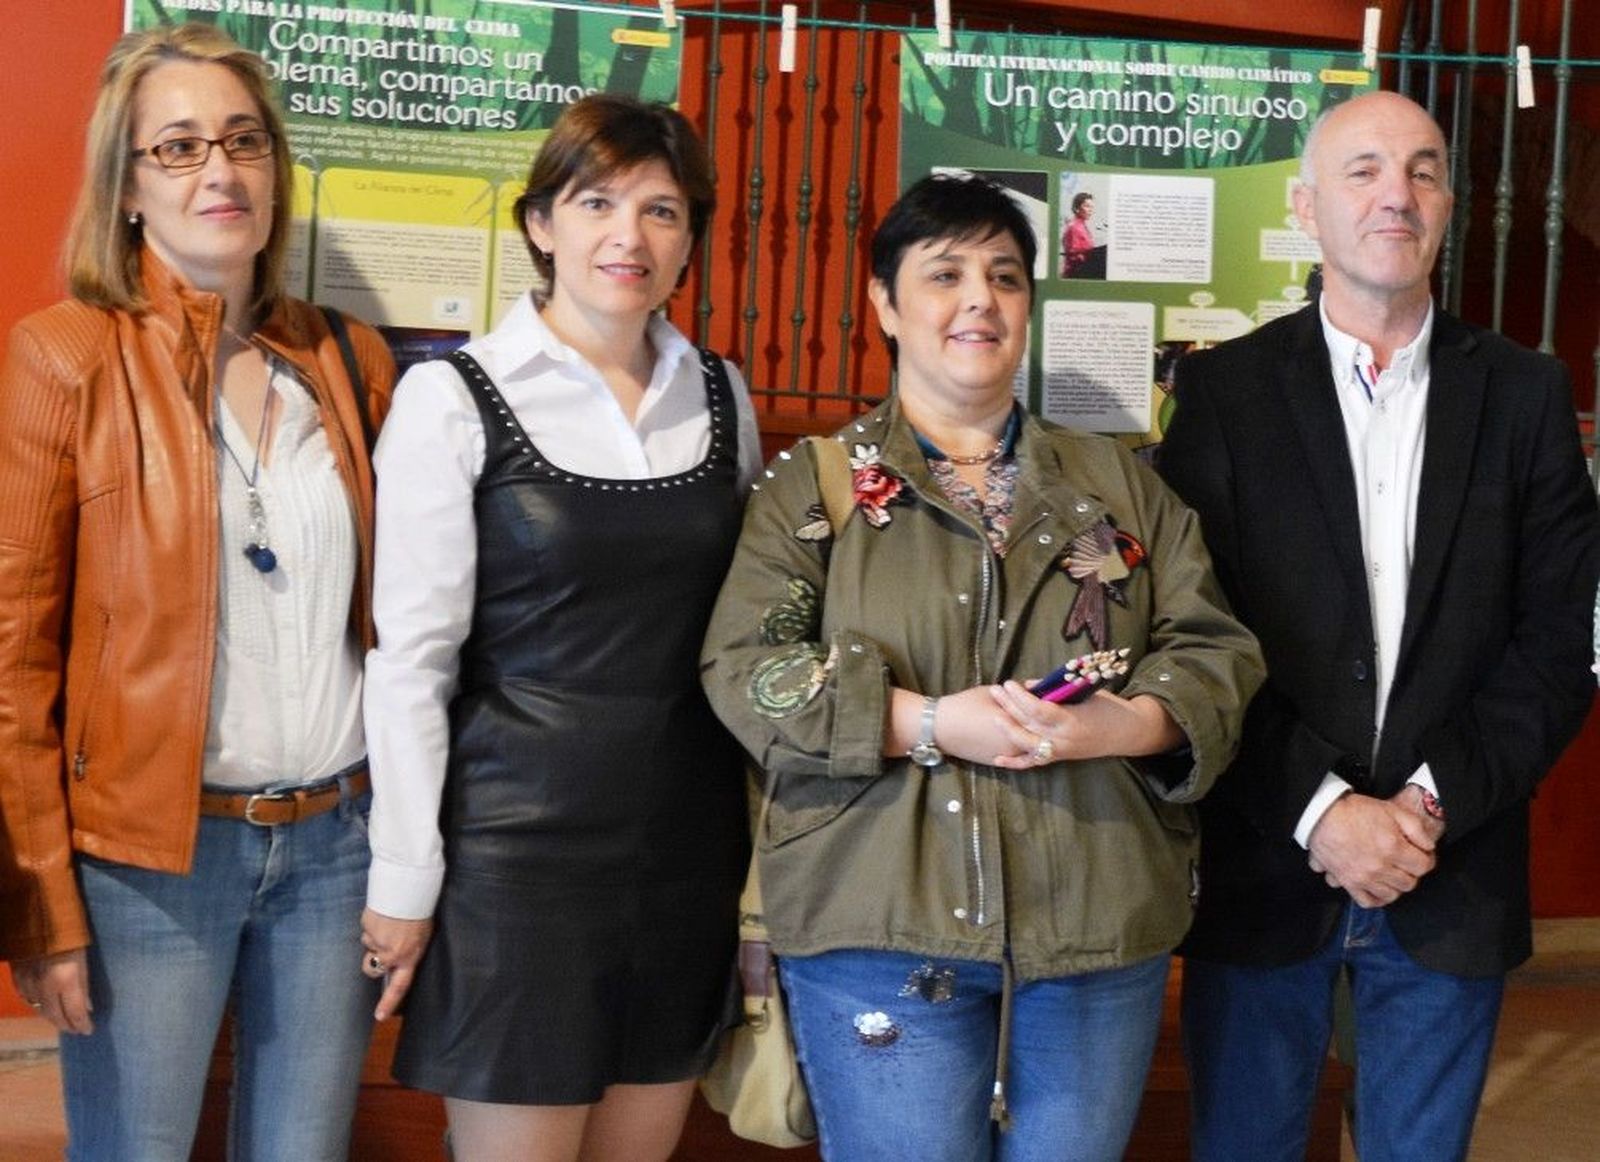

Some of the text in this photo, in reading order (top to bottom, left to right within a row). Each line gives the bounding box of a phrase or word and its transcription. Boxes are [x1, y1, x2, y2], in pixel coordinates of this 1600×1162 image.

[226, 0, 276, 17] PARA
[280, 3, 303, 19] LA
[306, 5, 418, 28] PROTECCIÓN
[424, 15, 458, 33] DEL
[465, 20, 521, 38] CLIMA
[269, 20, 543, 72] Compartimos un
[261, 50, 368, 91] blema,
[923, 52, 997, 69] POLÍTICA
[1000, 55, 1124, 75] INTERNACIONAL
[1126, 61, 1176, 77] SOBRE
[1178, 64, 1236, 80] CAMBIO
[1237, 66, 1313, 84] CLIMÁTICO
[290, 91, 517, 130] sus soluciones
[983, 71, 1308, 121] Un camino sinuoso
[1055, 116, 1242, 158] y complejo
